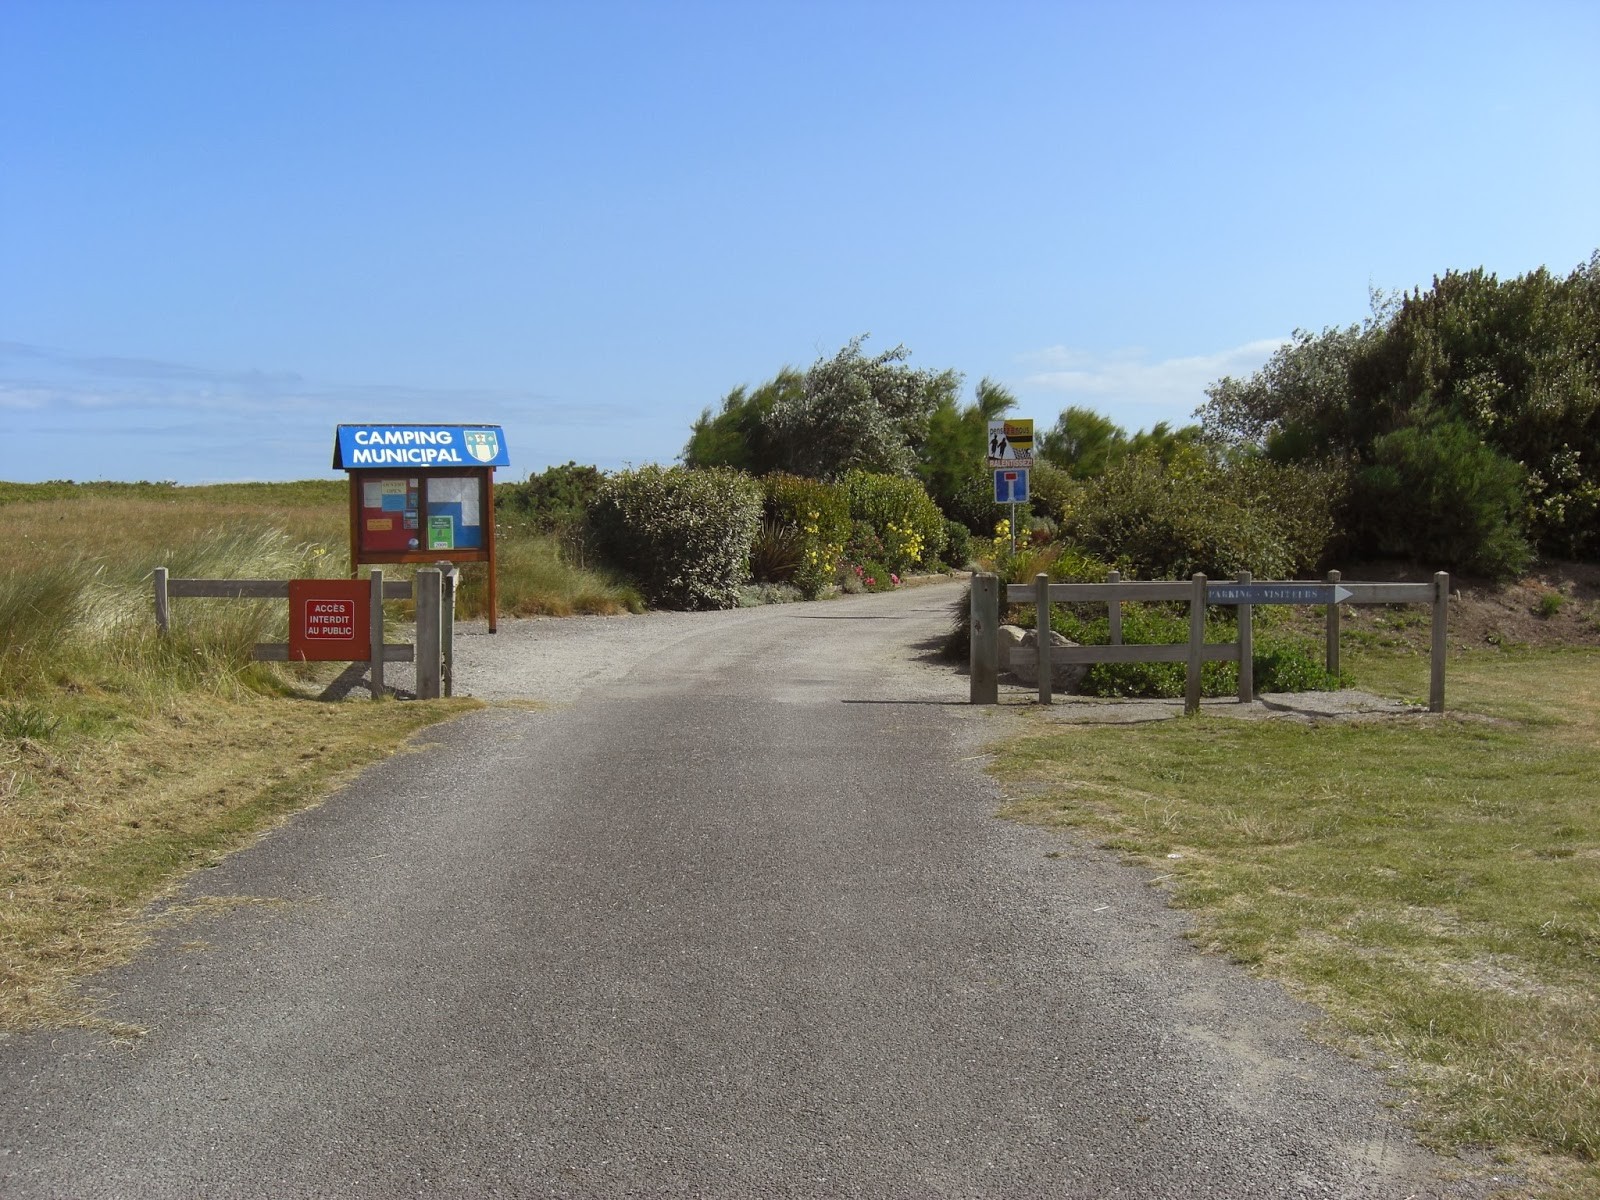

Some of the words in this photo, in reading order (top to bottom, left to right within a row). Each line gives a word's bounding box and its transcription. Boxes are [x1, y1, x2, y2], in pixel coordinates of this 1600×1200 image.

[354, 430, 453, 445] CAMPING
[352, 448, 462, 463] MUNICIPAL
[1208, 590, 1252, 598] PARKING
[314, 604, 345, 613] ACCÈS
[310, 616, 350, 624] INTERDIT
[322, 627, 352, 635] PUBLIC
